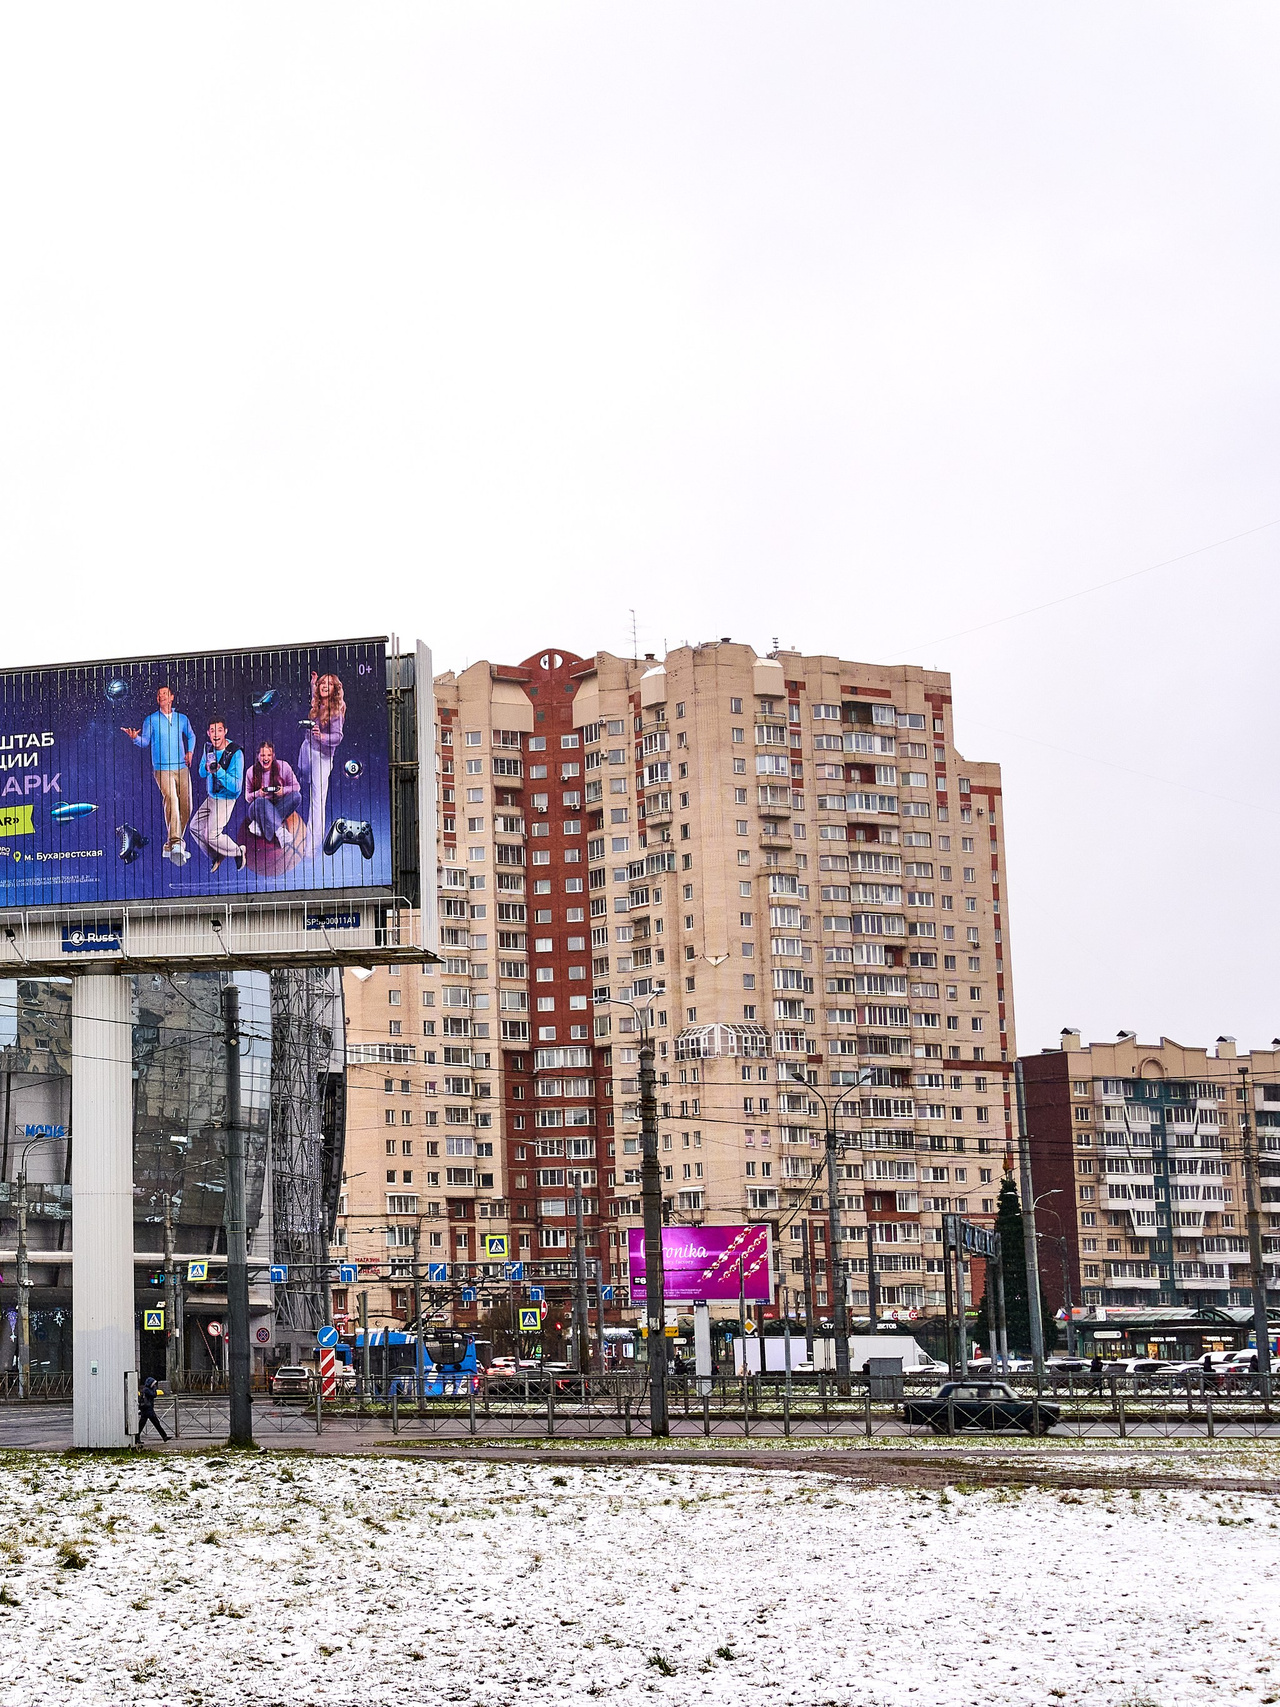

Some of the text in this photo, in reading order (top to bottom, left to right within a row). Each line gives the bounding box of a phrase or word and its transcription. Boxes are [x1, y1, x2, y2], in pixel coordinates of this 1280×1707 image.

[358, 664, 372, 675] 0+
[36, 850, 103, 861] Бухарестская
[87, 932, 114, 942] Russ
